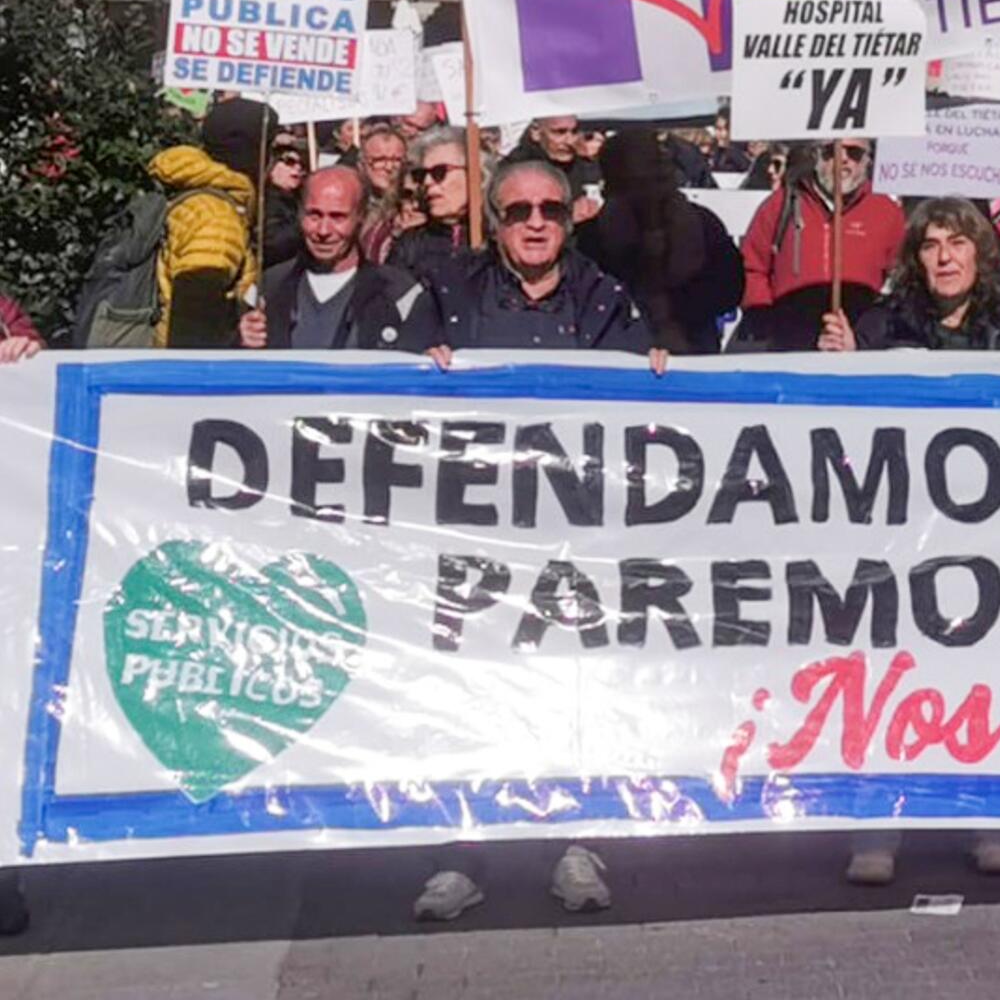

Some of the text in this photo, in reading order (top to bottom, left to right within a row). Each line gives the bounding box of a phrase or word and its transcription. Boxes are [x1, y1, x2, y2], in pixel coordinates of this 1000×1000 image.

[783, 0, 884, 25] HOSPITAL
[183, 24, 350, 67] NO SE VENDE
[743, 28, 922, 59] VALLE DEL TIÉTAR
[173, 56, 209, 82] SE
[217, 60, 353, 94] DEFIENDE
[878, 161, 899, 179] NO
[900, 160, 918, 180] SE
[920, 162, 949, 179] NOS
